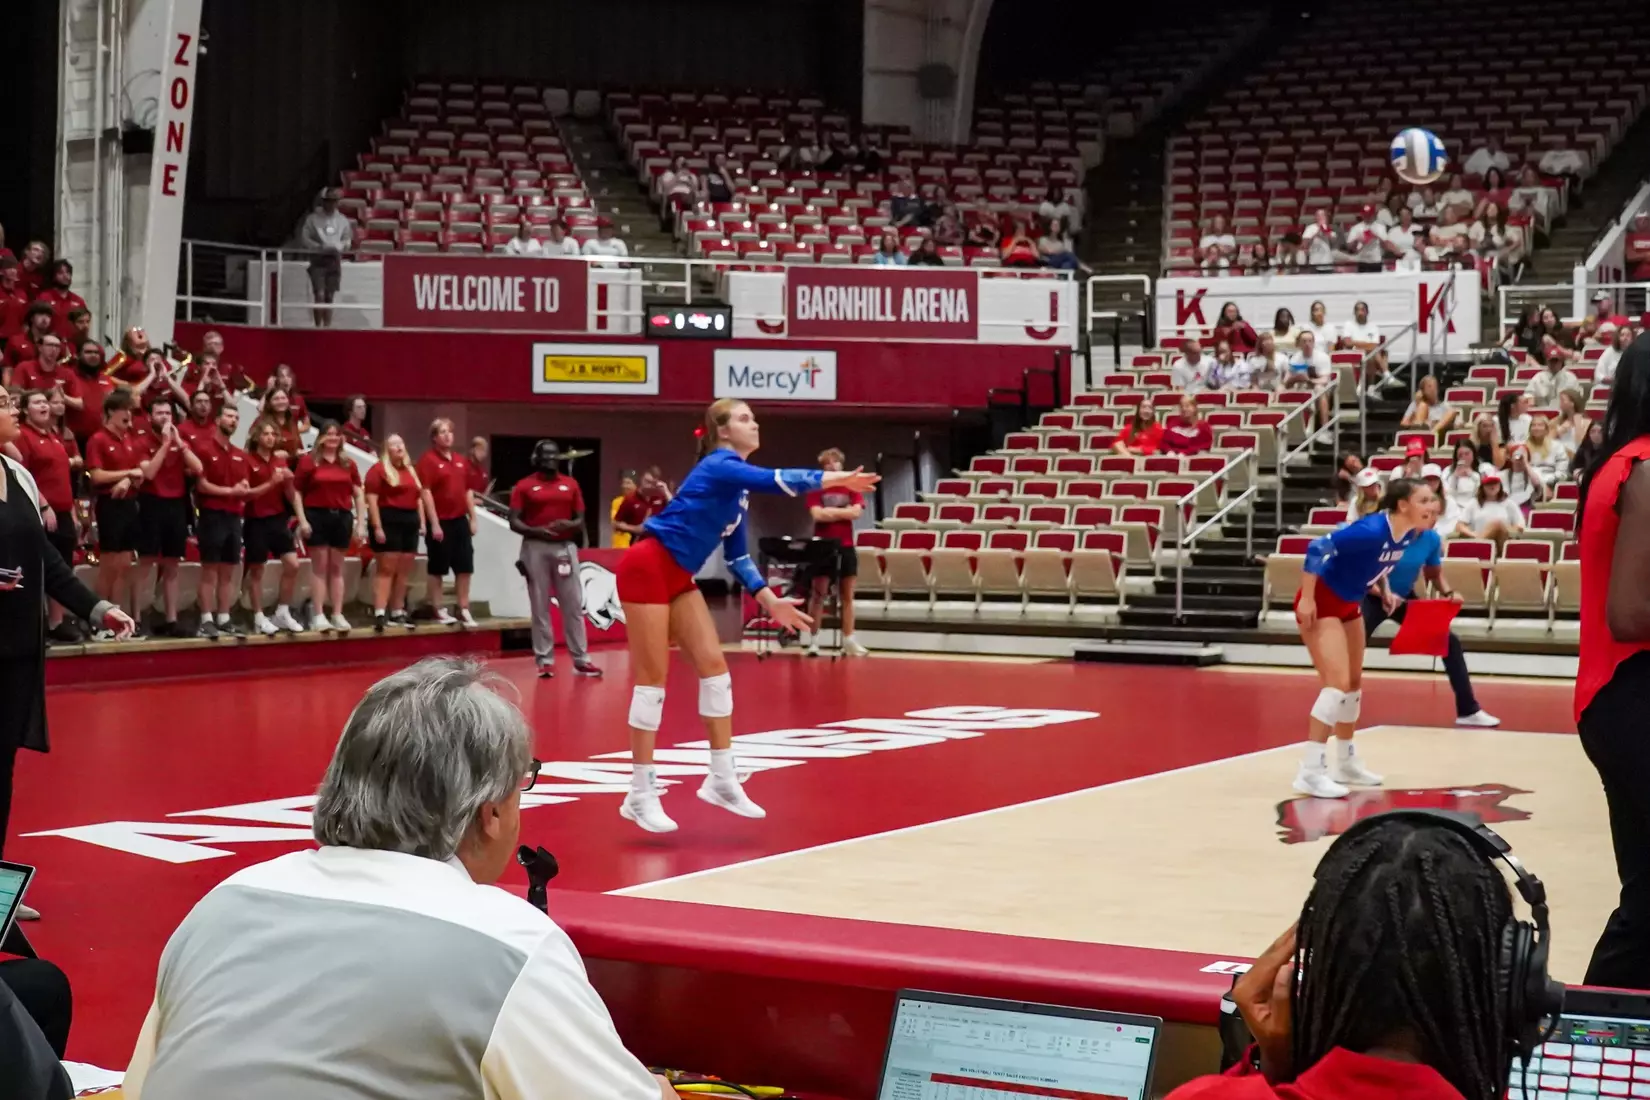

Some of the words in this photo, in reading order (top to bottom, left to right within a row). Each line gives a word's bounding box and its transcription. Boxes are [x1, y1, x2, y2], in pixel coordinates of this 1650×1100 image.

[162, 33, 192, 197] ZONE
[413, 274, 526, 312] WELCOME
[532, 277, 560, 313] TO
[796, 285, 896, 322] BARNHILL
[901, 287, 970, 323] ARENA
[1176, 288, 1209, 335] K
[1418, 282, 1457, 333] K
[728, 365, 802, 394] Mercy
[18, 704, 1100, 864] AANSAS
